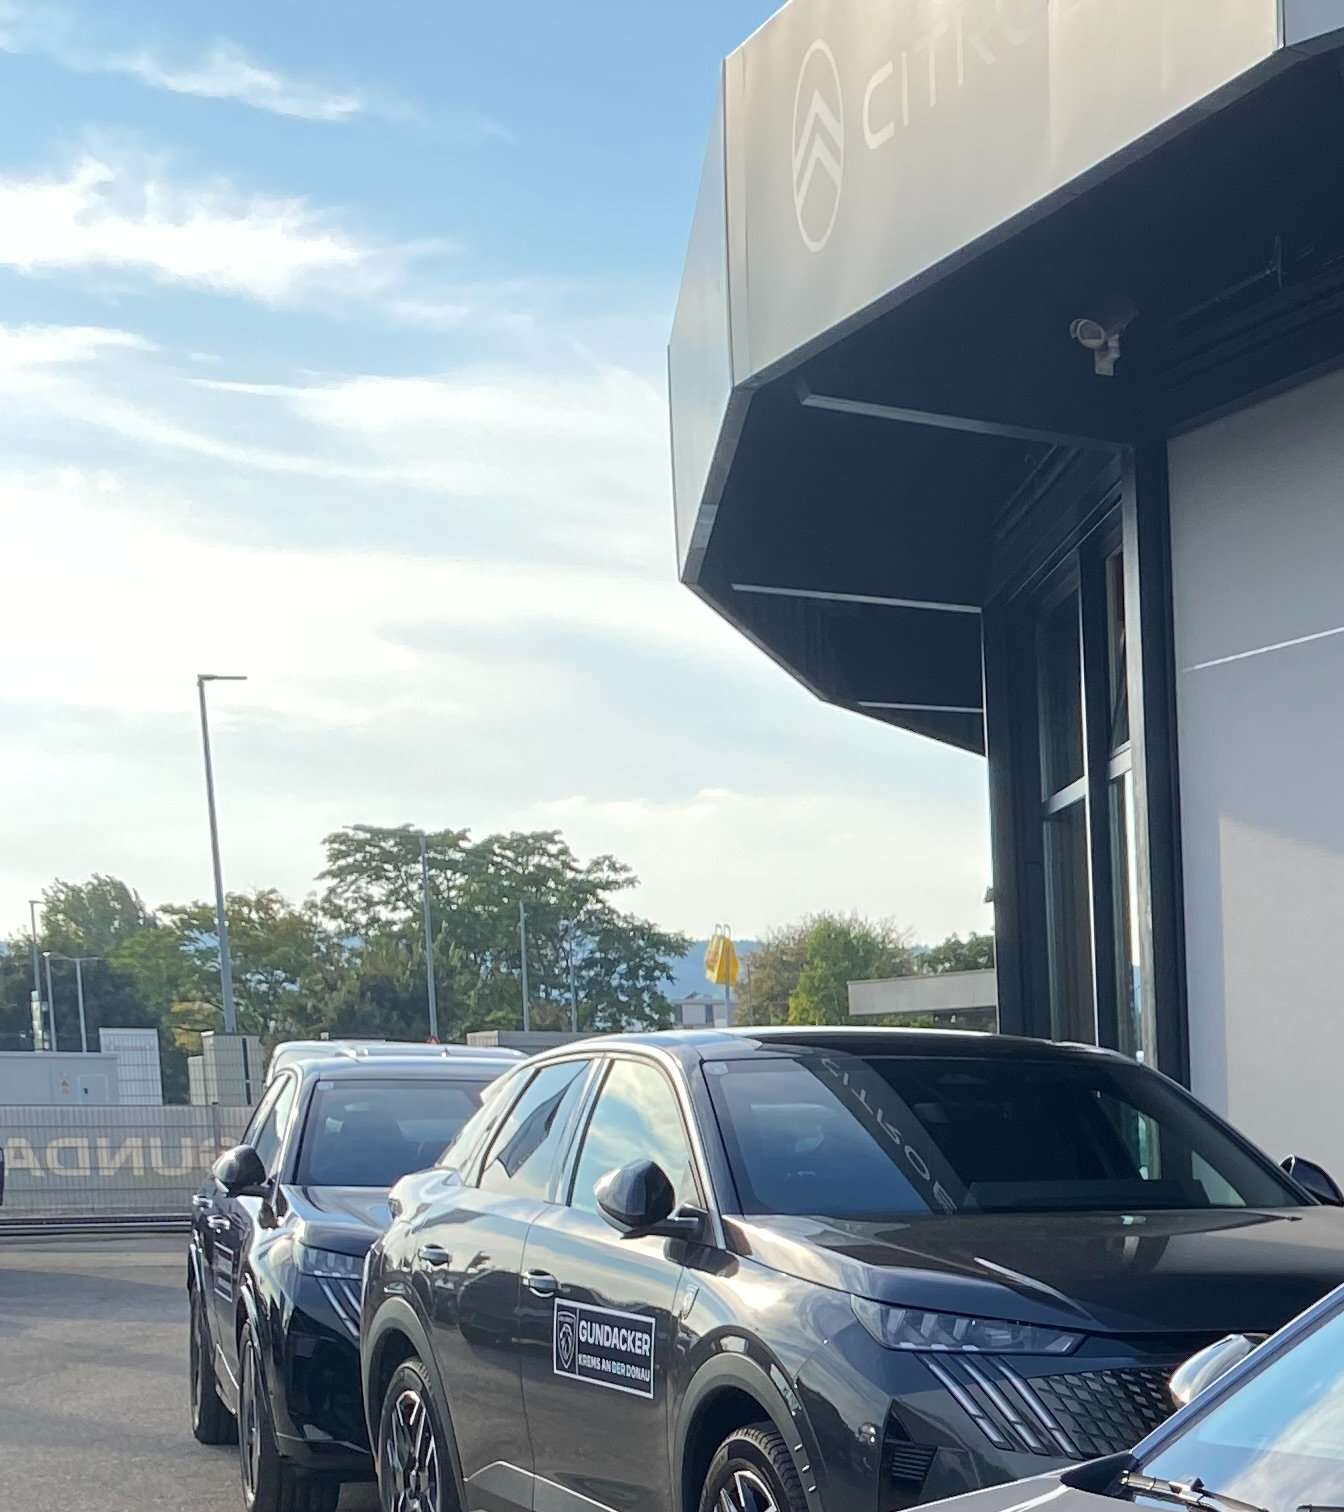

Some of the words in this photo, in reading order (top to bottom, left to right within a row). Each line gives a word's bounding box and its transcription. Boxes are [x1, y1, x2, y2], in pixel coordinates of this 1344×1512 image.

[579, 1320, 650, 1356] GUNDACKER
[578, 1353, 601, 1370] KREMS
[601, 1359, 611, 1372] AN
[612, 1361, 625, 1376] DER
[626, 1366, 650, 1382] DONAU
